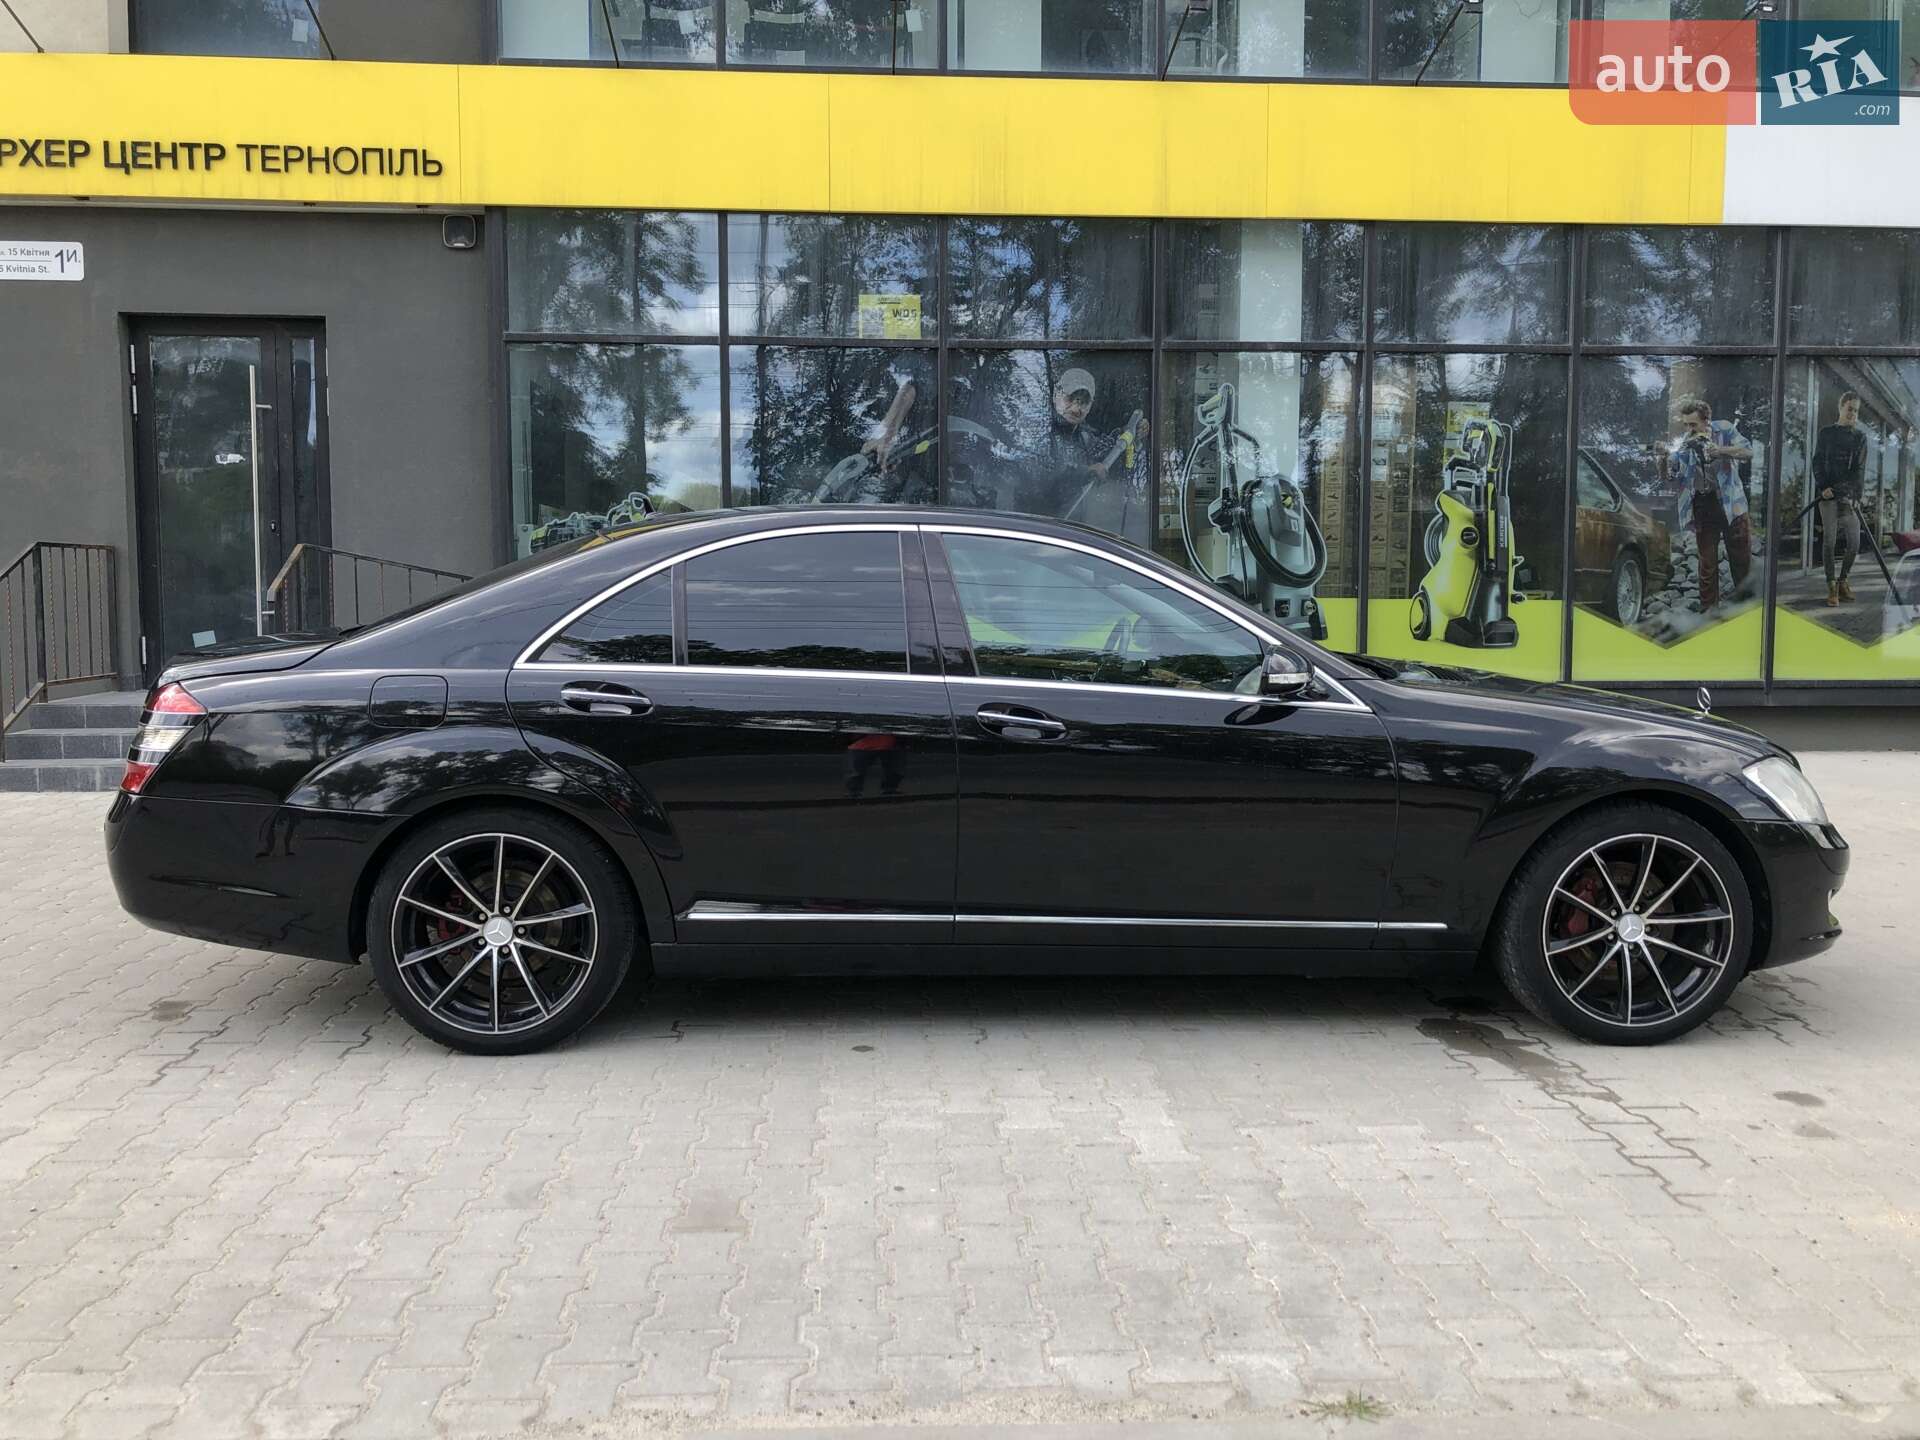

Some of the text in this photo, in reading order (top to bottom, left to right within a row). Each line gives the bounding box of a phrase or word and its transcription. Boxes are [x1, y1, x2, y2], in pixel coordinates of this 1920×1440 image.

[103, 140, 226, 175] ЦЕНТР
[236, 143, 443, 177] ТЕРНОПІЛЬ
[8, 248, 18, 256] 15
[20, 248, 50, 257] Квітня
[6, 265, 36, 273] Kvitnia
